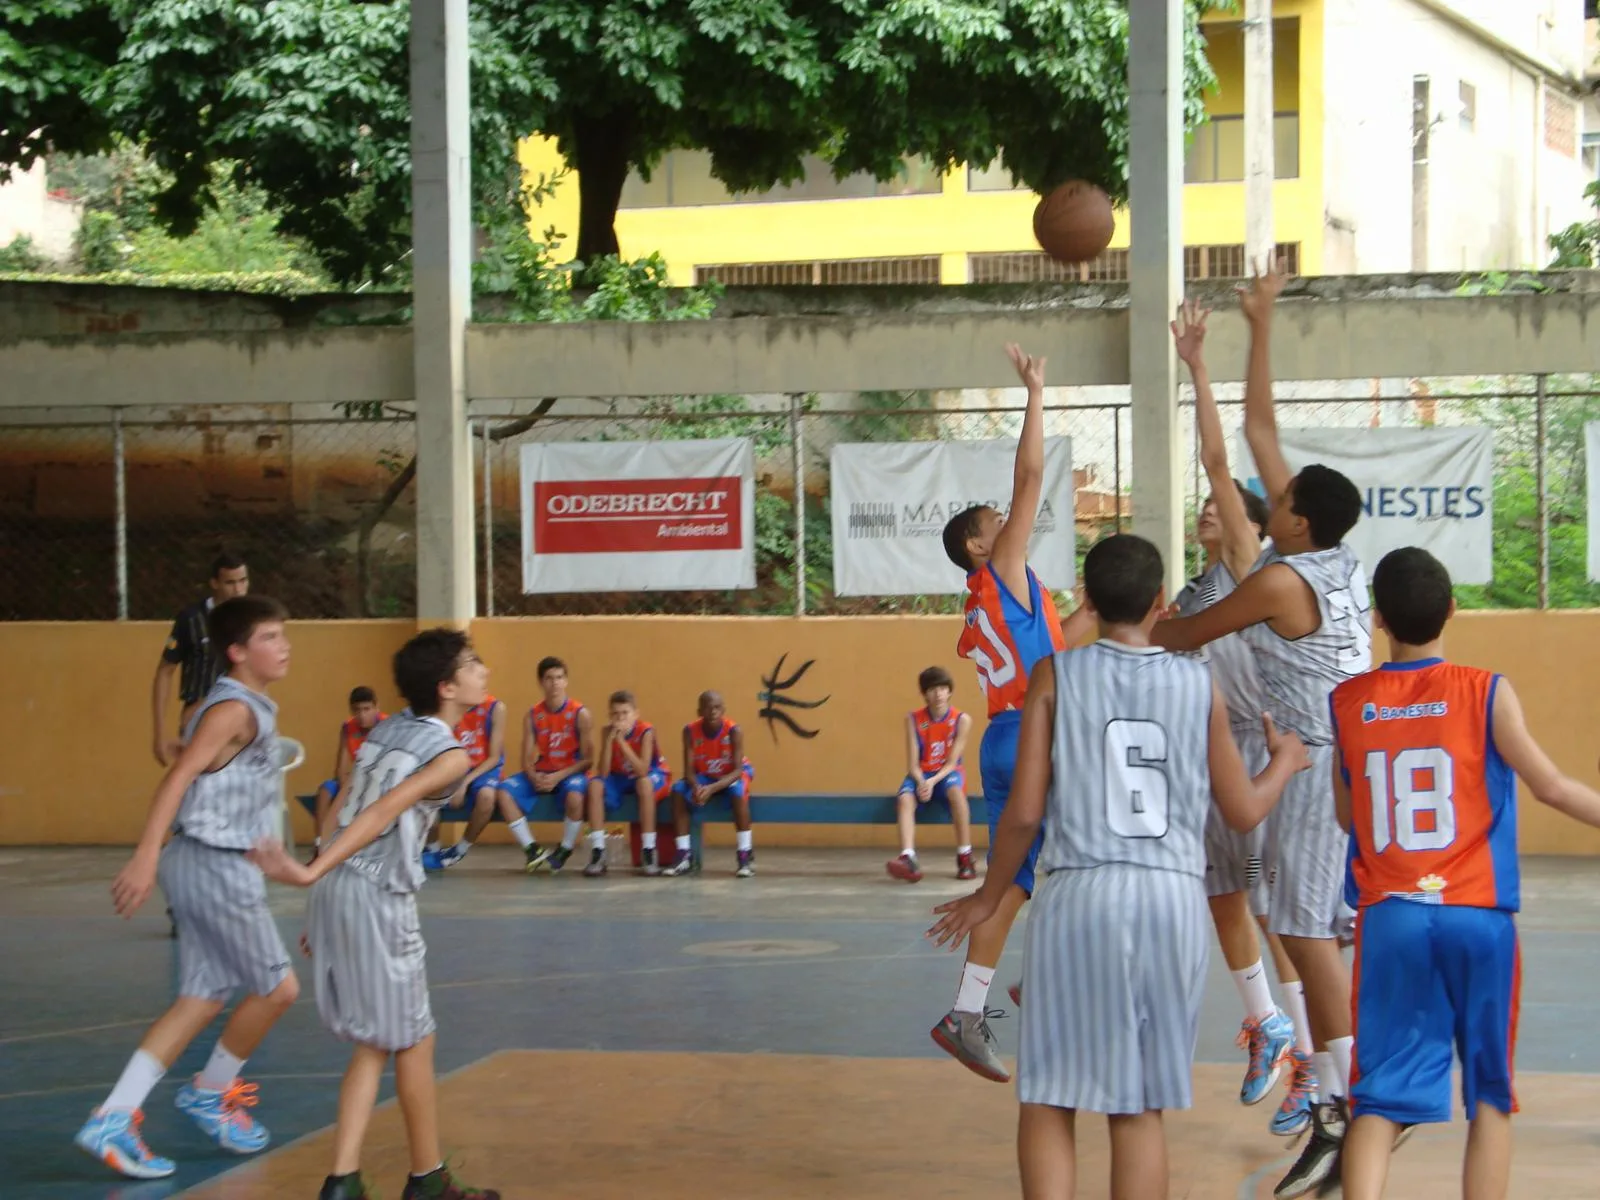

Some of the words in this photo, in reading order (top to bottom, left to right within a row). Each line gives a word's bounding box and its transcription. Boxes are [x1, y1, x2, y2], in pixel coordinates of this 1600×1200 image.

[547, 491, 728, 515] ODEBRECHT
[656, 522, 728, 537] Ambiental
[1380, 702, 1448, 720] BANESTES
[1103, 718, 1170, 839] 6
[1364, 746, 1457, 856] 18
